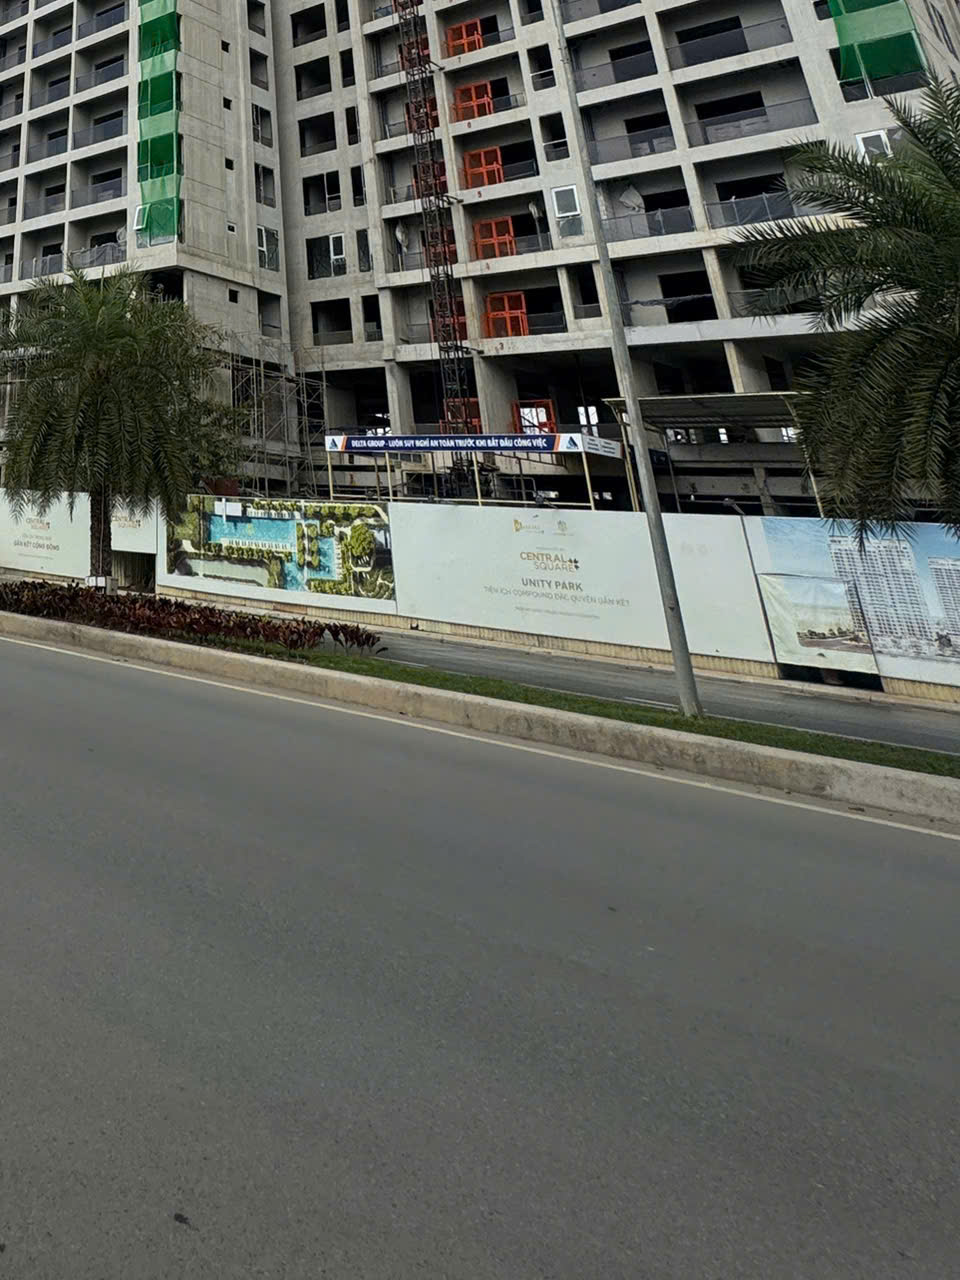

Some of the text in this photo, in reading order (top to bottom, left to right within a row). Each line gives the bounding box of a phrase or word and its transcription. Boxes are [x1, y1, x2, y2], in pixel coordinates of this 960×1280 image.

[351, 439, 366, 448] DELTA
[367, 439, 385, 448] GROUP
[404, 439, 414, 448] SUY
[430, 439, 438, 447] AN
[520, 551, 567, 563] CENTRAL
[534, 561, 575, 572] SQUARE
[521, 577, 583, 592] UNITY PARK
